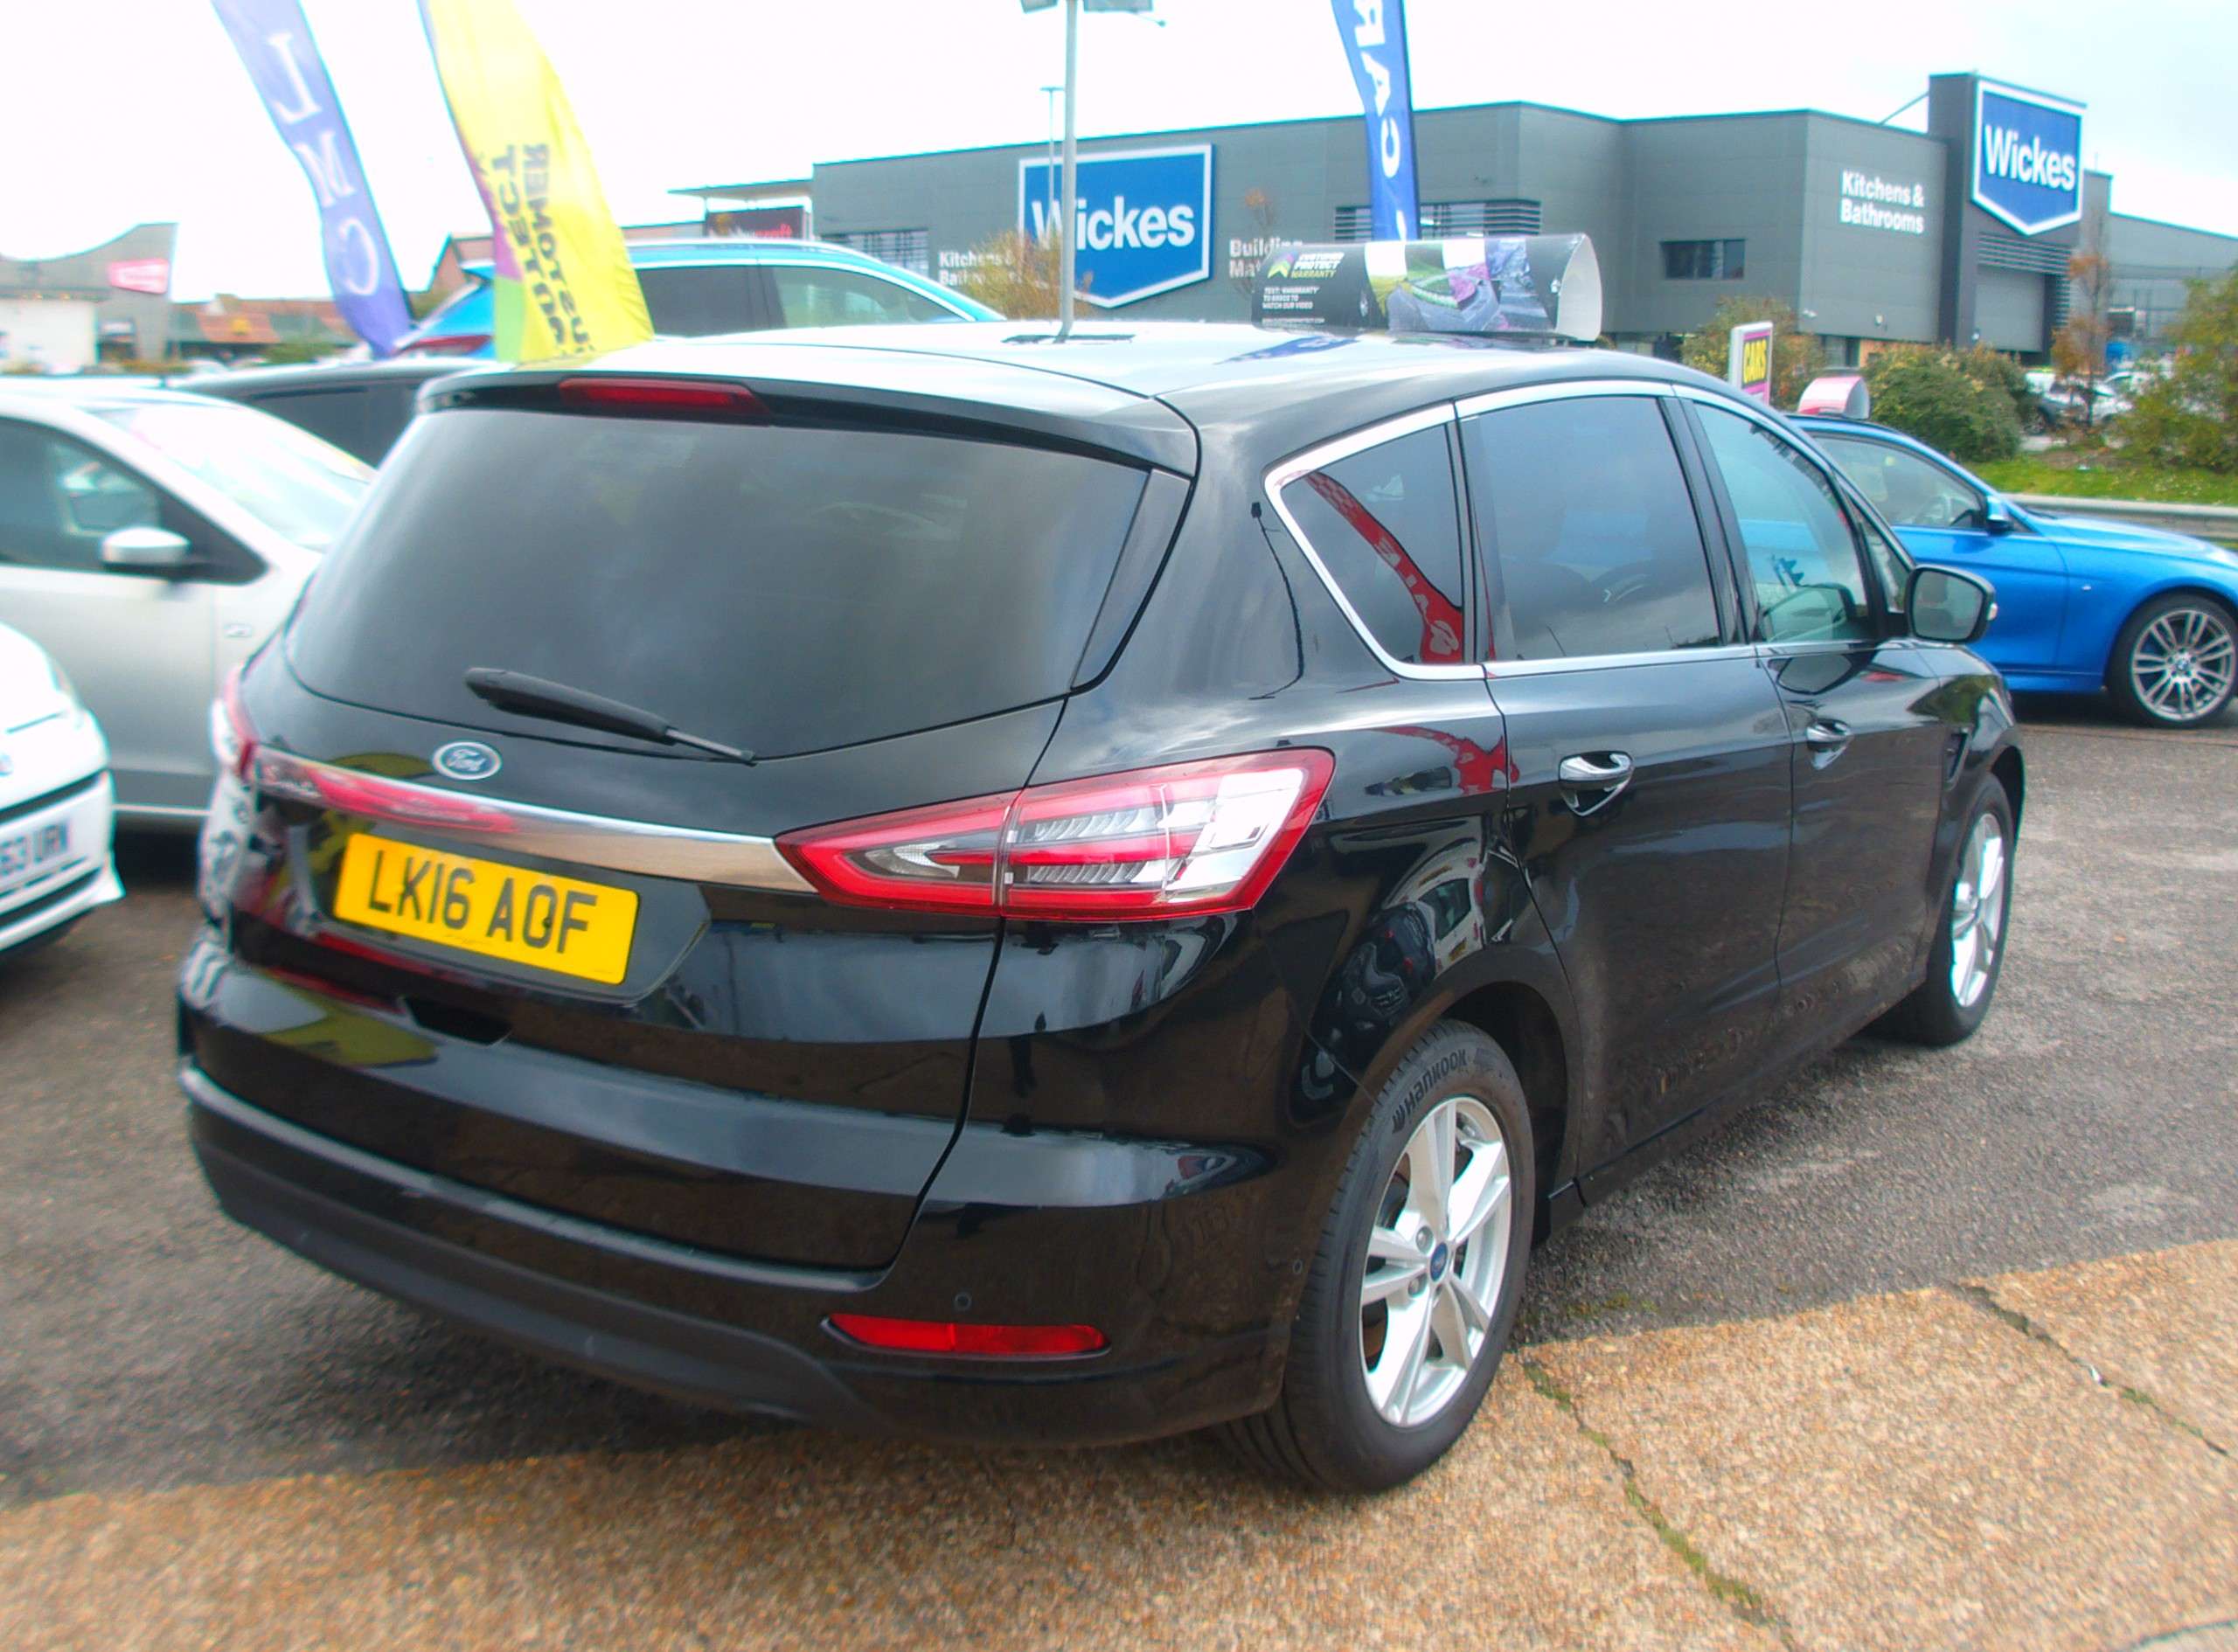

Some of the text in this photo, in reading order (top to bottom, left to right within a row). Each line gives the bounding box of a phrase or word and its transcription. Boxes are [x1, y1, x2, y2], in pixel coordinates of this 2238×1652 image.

[1984, 124, 2075, 191] Wickes
[1842, 170, 1924, 207] Kitchens &
[1032, 196, 1196, 251] Wickes
[1840, 198, 1924, 234] Bathrooms
[1744, 338, 1768, 384] CARS
[368, 849, 599, 954] LK16 AOF
